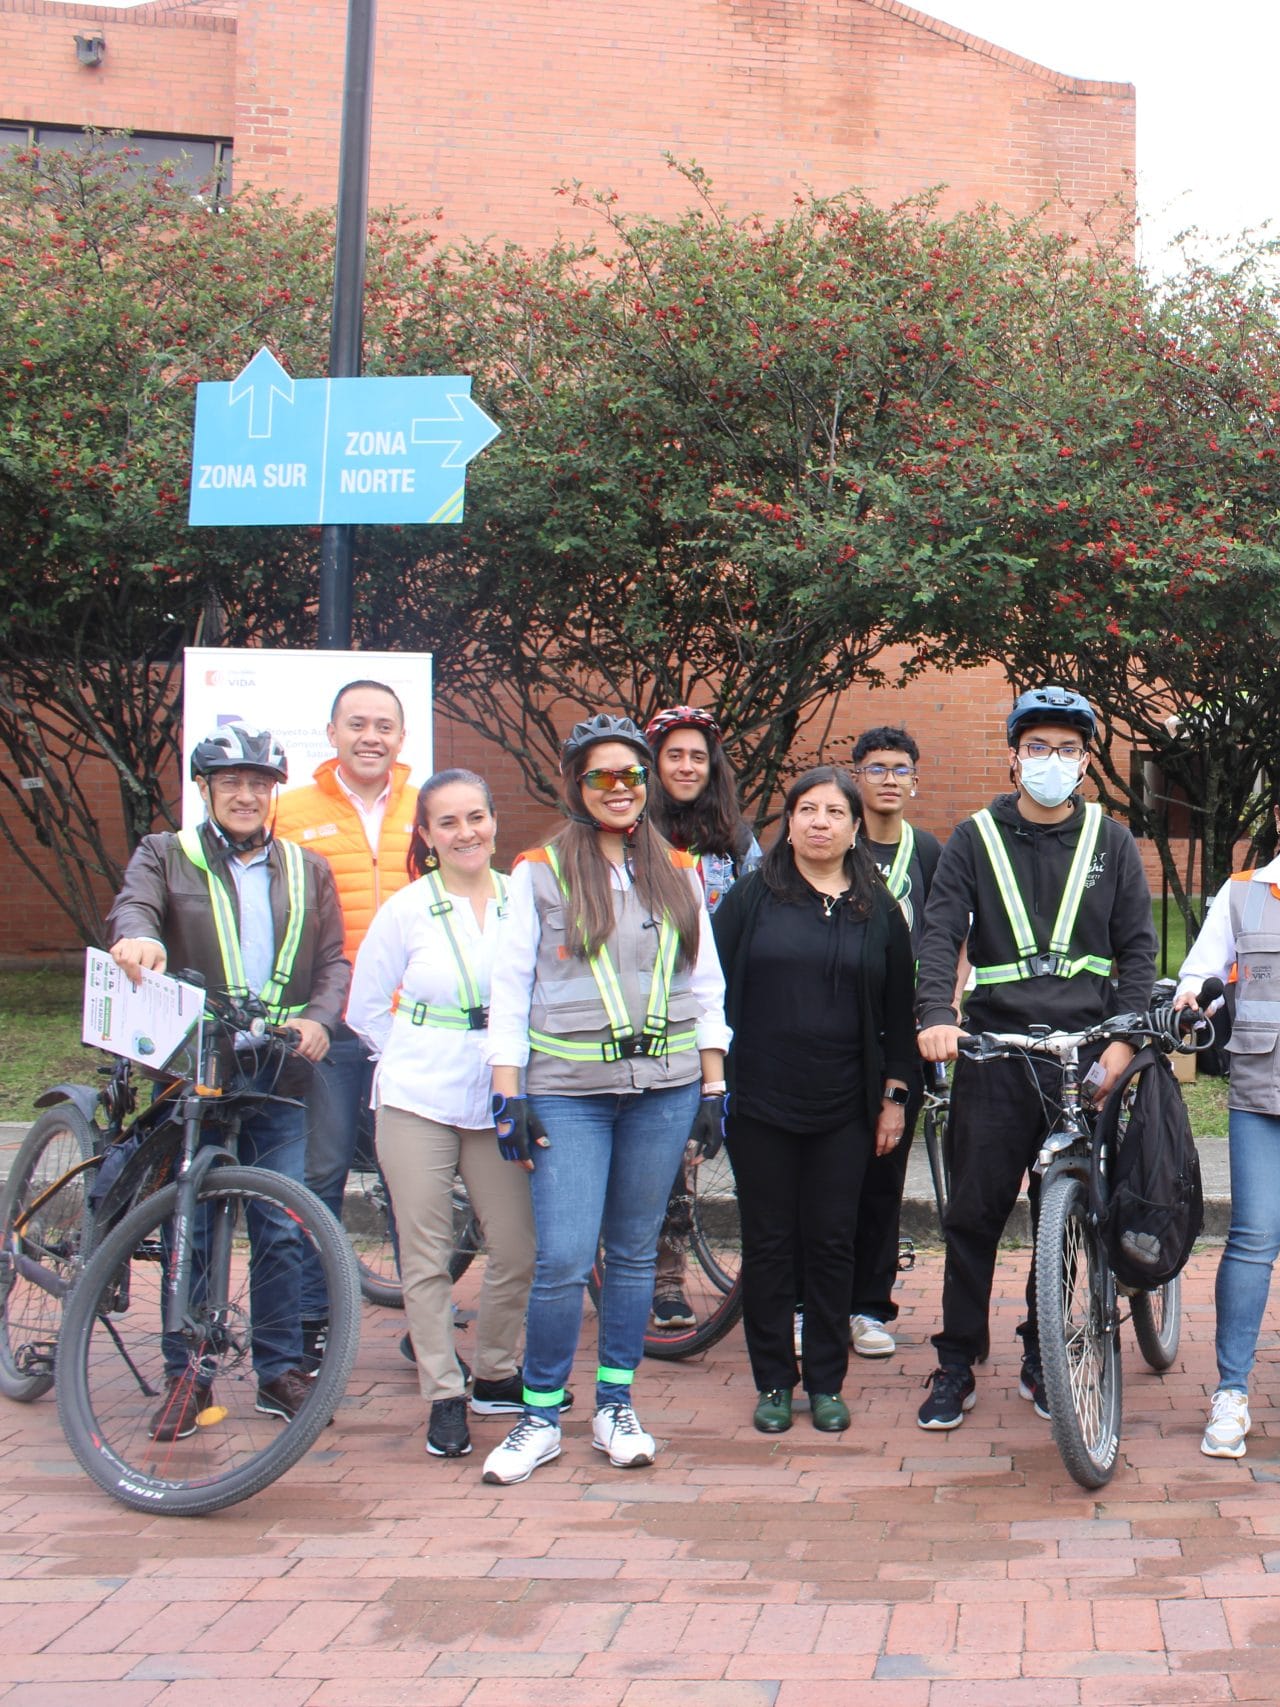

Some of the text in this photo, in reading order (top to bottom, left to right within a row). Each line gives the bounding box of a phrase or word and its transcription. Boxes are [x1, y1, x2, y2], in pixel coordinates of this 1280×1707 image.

[345, 432, 407, 456] ZONA
[198, 463, 307, 489] ZONA SUR
[340, 468, 415, 494] NORTE
[228, 679, 256, 687] VIDA
[118, 1479, 165, 1500] KENDA
